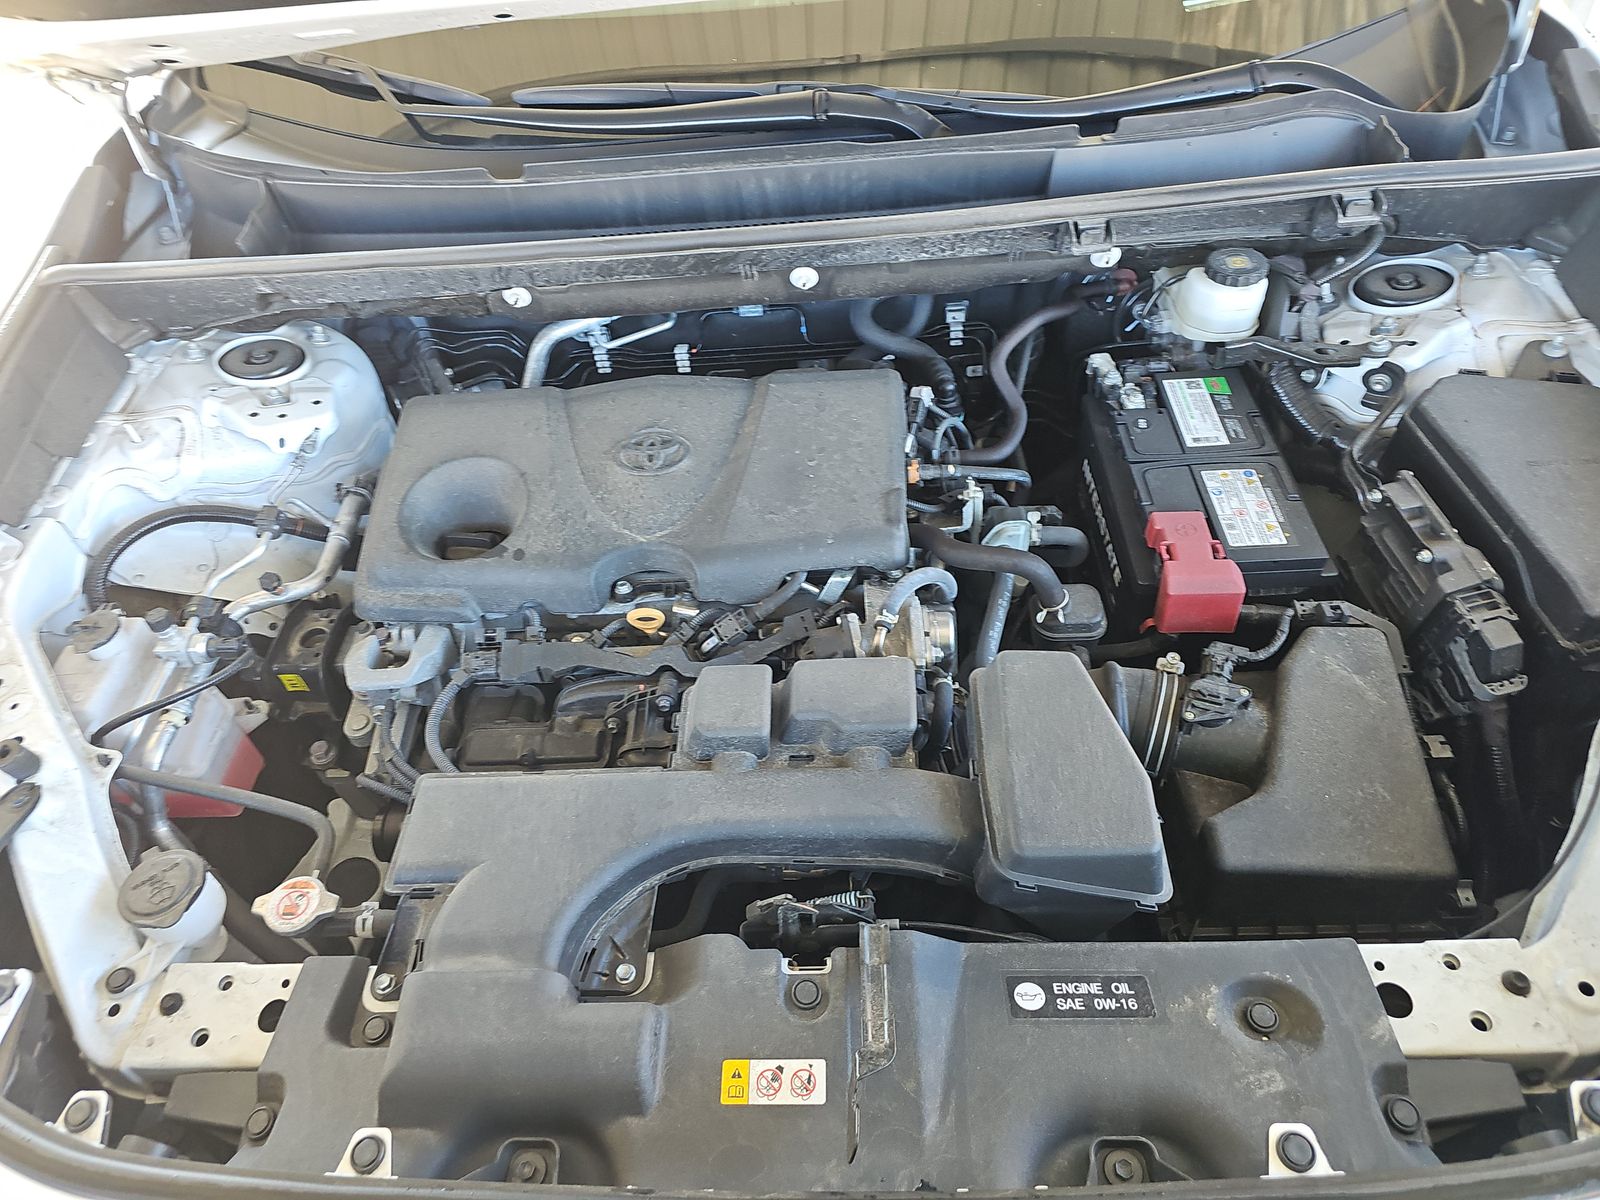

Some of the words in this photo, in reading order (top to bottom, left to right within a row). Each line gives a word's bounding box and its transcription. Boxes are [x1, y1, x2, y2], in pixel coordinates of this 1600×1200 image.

[1052, 982, 1103, 994] ENGINE
[1110, 982, 1135, 994] OIL
[1056, 997, 1085, 1010] SAE
[1094, 997, 1138, 1010] 0W-16
